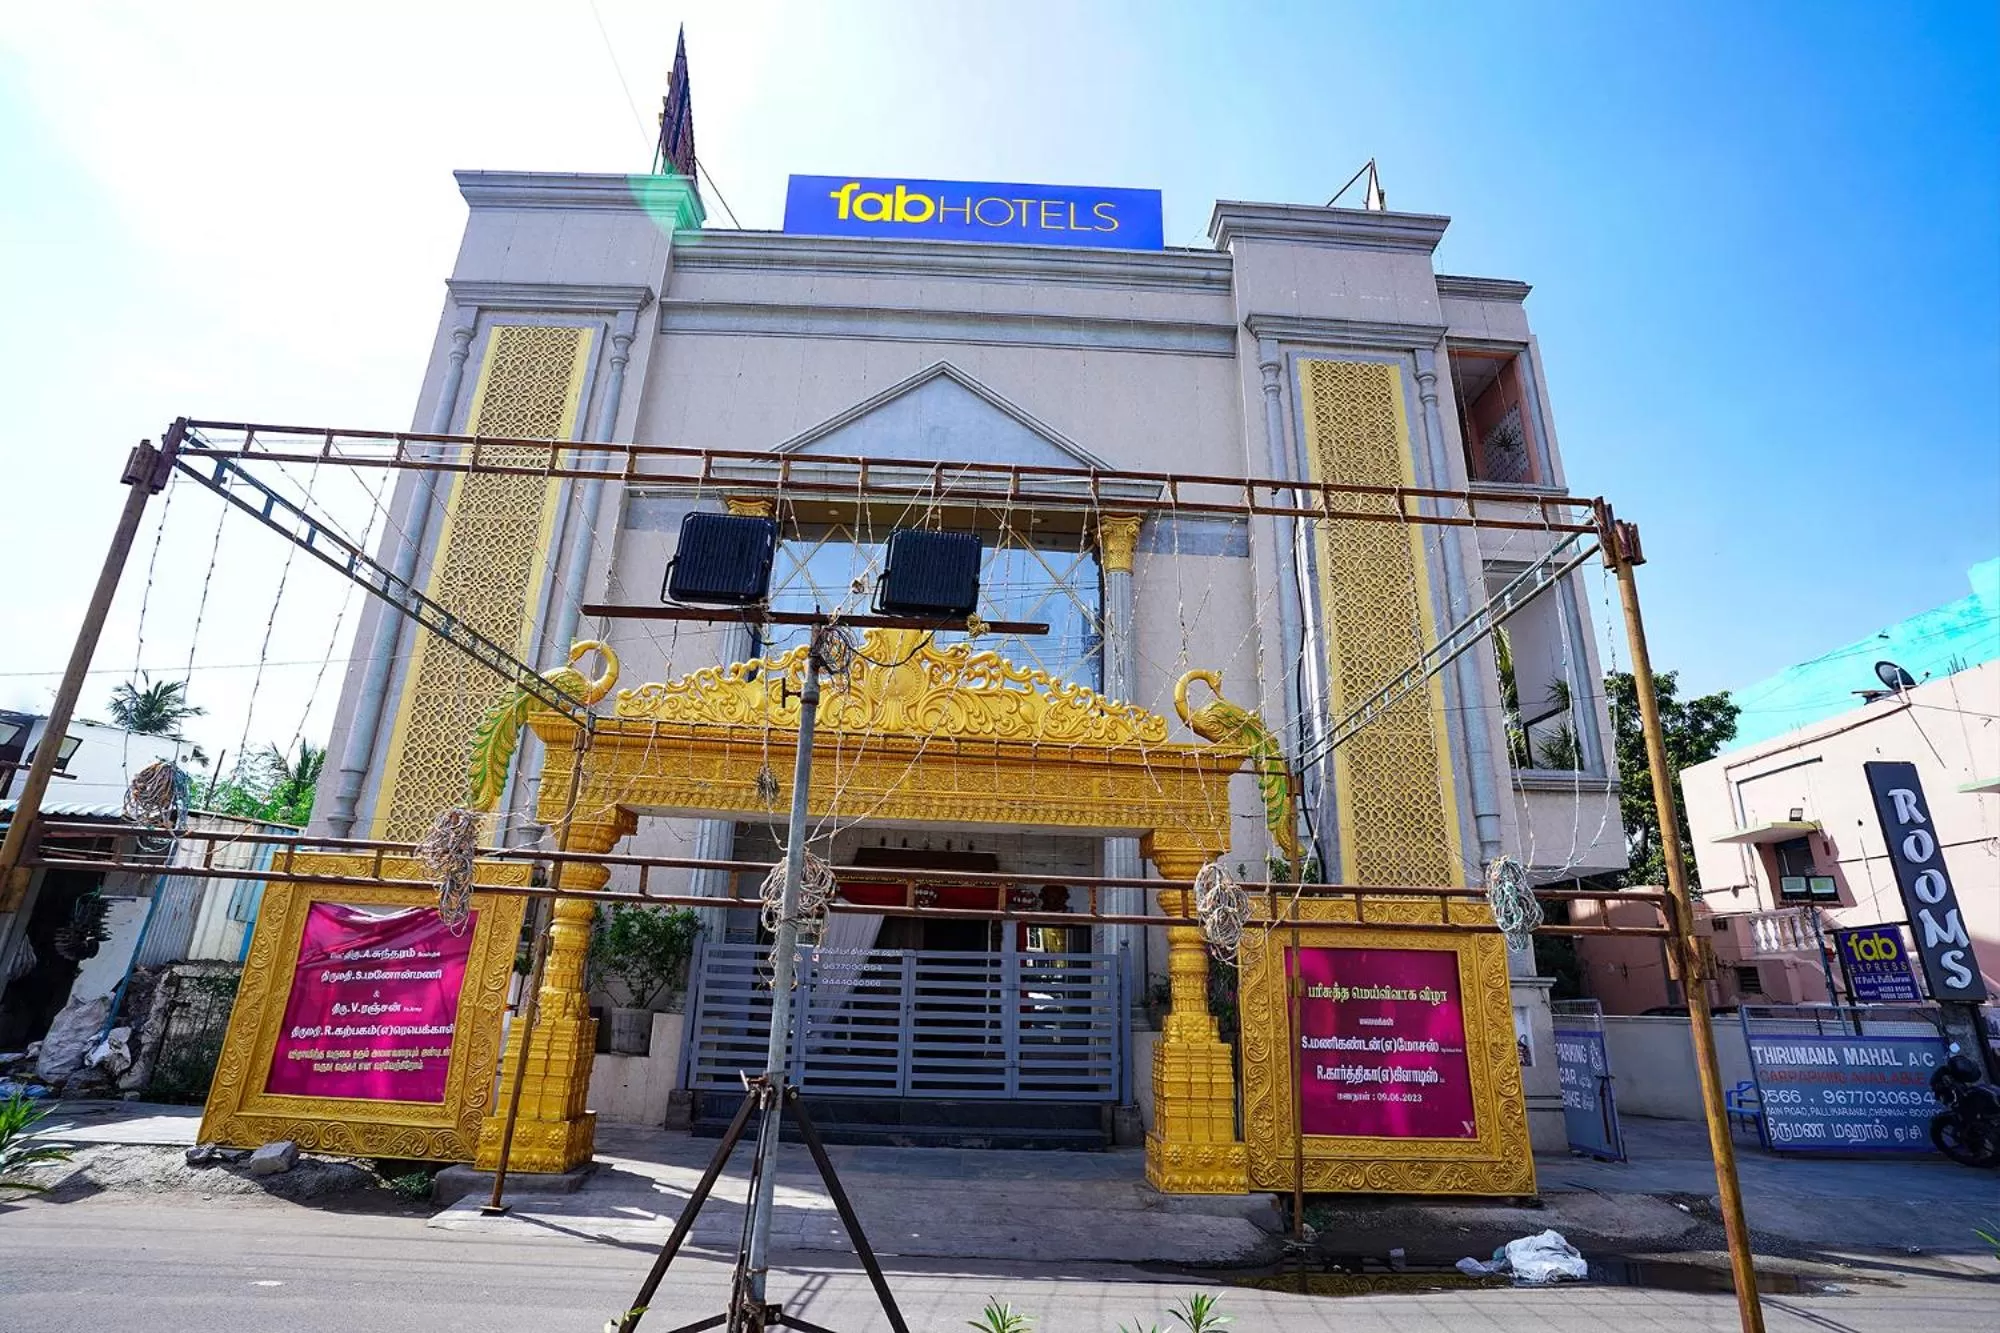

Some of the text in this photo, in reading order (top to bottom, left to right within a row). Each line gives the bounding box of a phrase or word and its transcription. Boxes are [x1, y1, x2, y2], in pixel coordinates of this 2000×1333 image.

[1887, 788, 1972, 989] ROOMS
[1847, 932, 1897, 961] fab
[1850, 961, 1908, 974] EXPRESS
[1308, 982, 1447, 1006] பரிசுத்த மெய்விவாக விழா
[1752, 1046, 1936, 1067] THIRUMANA MAHAL A/C
[1560, 1067, 1578, 1085] CAR
[1823, 1089, 1936, 1105] 9677030694
